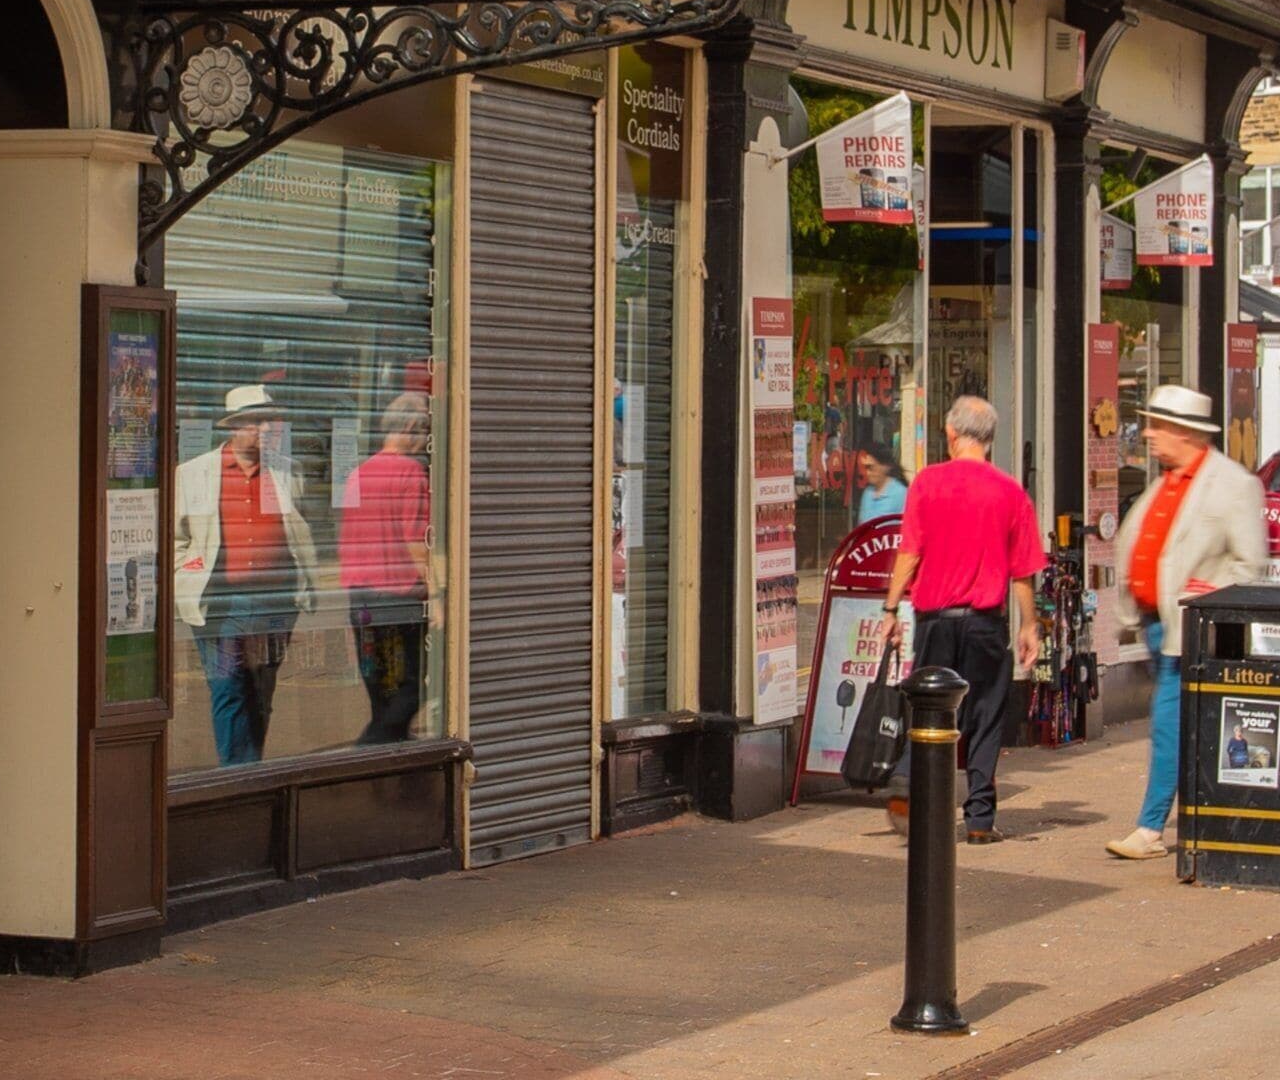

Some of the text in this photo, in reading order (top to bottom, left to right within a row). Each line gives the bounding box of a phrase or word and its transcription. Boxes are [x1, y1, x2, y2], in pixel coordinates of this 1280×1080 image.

[623, 78, 685, 122] Speciality
[627, 118, 680, 152] Cordials
[843, 136, 905, 153] PHONE
[845, 155, 906, 169] REPAIRS
[264, 165, 338, 201] Liquorice
[355, 175, 400, 207] Toffee
[1156, 193, 1207, 208] PHONE
[1156, 209, 1208, 221] REPAIRS
[624, 217, 680, 247] Ice Cream
[827, 347, 893, 408] Price
[810, 432, 869, 508] Keys
[110, 528, 154, 544] OTHELLO
[849, 533, 904, 565] TIMP
[858, 619, 911, 637] HAF
[849, 662, 872, 676] KEY
[1223, 667, 1274, 685] Litter
[1242, 718, 1271, 728] your
